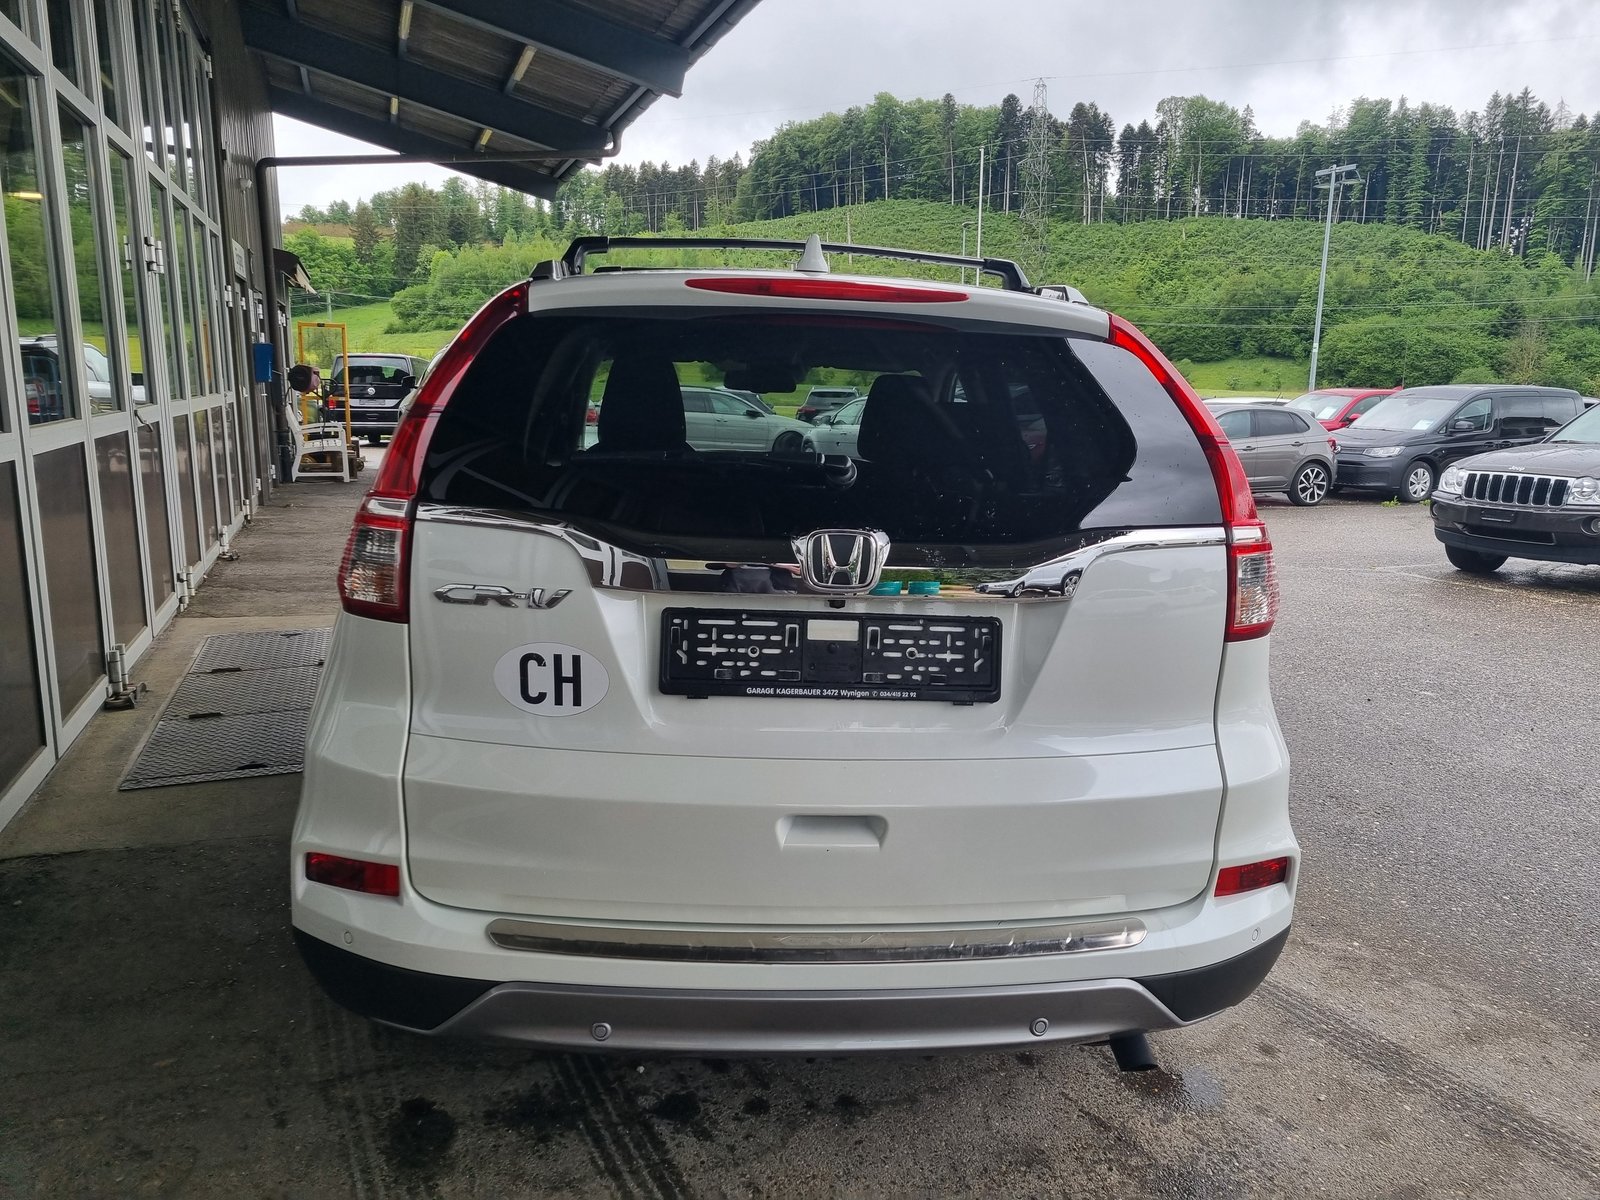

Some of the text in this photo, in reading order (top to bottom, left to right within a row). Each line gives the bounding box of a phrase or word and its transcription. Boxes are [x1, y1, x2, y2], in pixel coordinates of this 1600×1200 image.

[433, 583, 574, 610] CR-V
[519, 652, 582, 707] CH
[746, 687, 775, 695] GARAGE
[776, 687, 822, 696] KAGERBAUER
[822, 688, 839, 696] 3472
[840, 688, 870, 698] Wynigen
